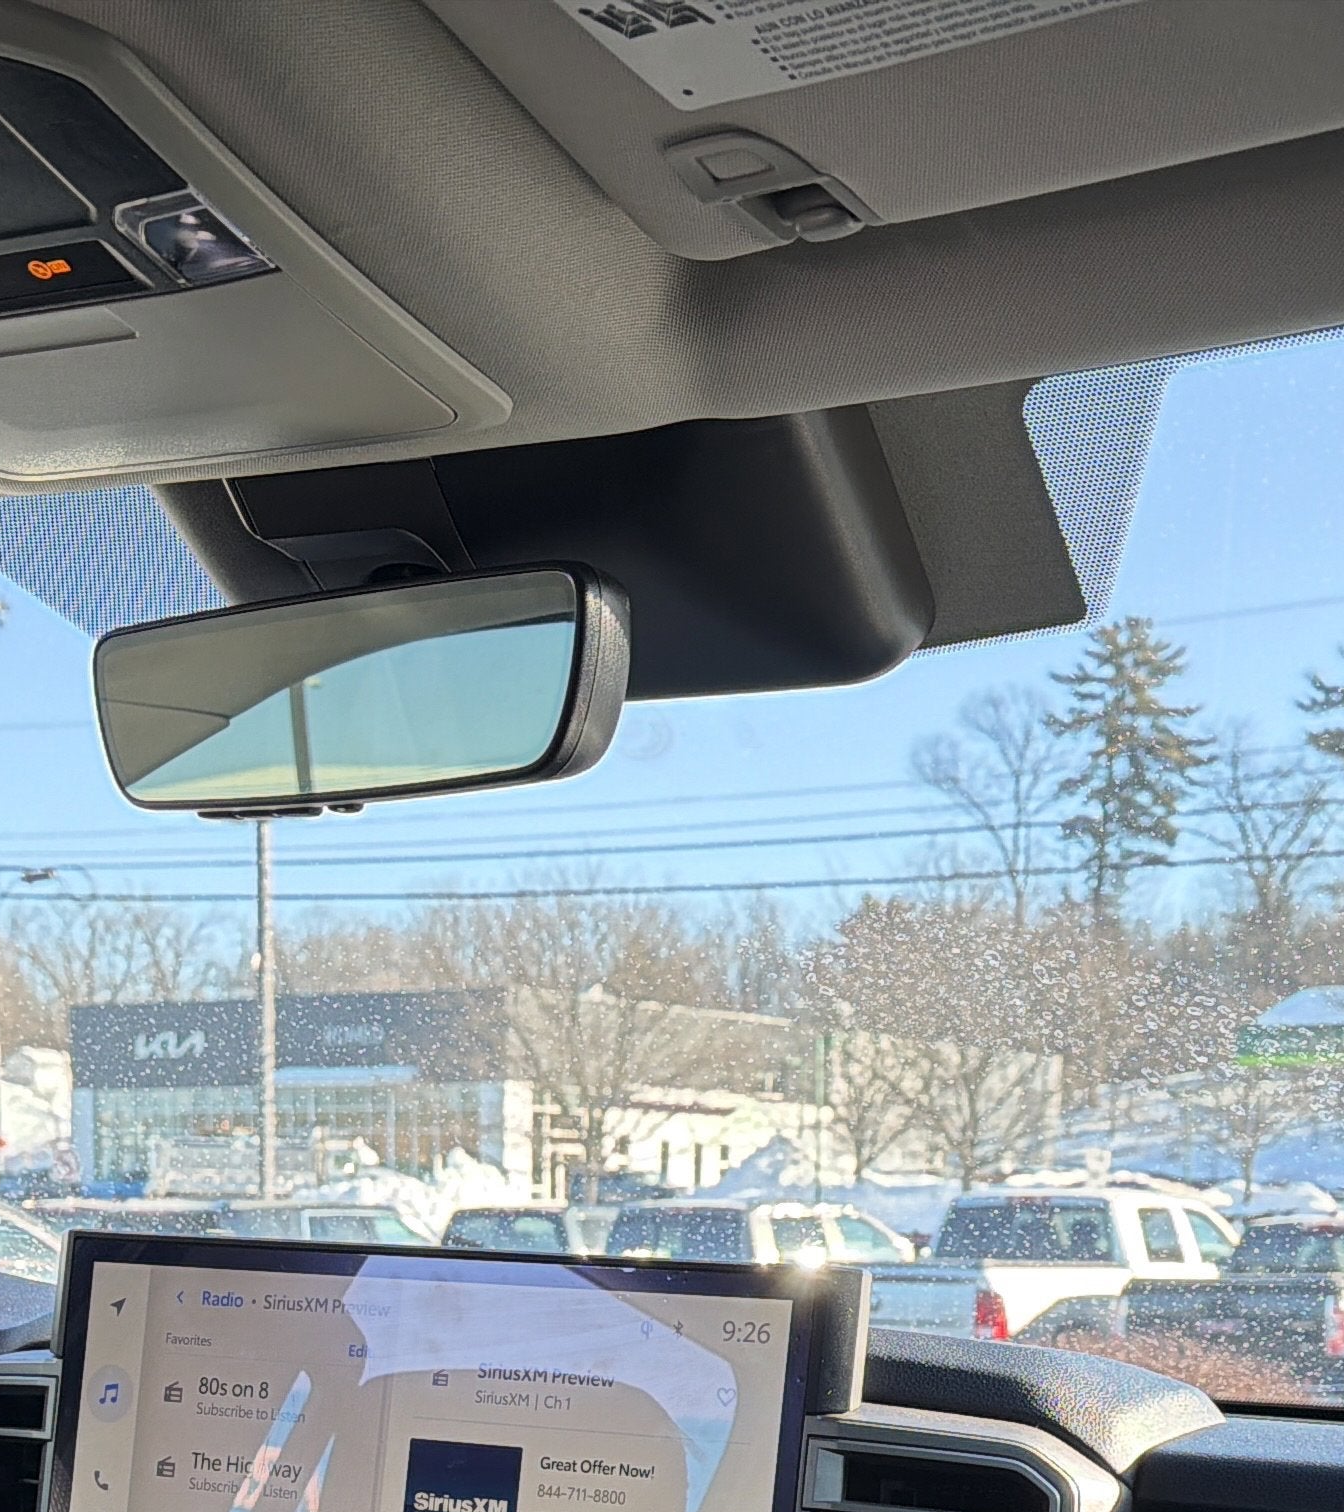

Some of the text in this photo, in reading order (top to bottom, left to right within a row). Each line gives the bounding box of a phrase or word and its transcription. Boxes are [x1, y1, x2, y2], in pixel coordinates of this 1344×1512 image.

[202, 1290, 244, 1308] Radio
[263, 1294, 329, 1314] SiriusXM
[165, 1332, 212, 1348] Favorites
[722, 1320, 772, 1344] 9:26
[348, 1344, 372, 1359] Edi
[477, 1362, 615, 1388] SiriusXM Preview
[199, 1377, 270, 1400] 80s on 8
[474, 1390, 530, 1408] SiriusXM
[196, 1401, 306, 1424] Subscribe to Listen
[192, 1452, 302, 1483] The Hiway
[540, 1456, 655, 1480] Great Offer Now!
[188, 1477, 297, 1501] Subscrib Listen
[537, 1484, 626, 1506] 844-711-8800
